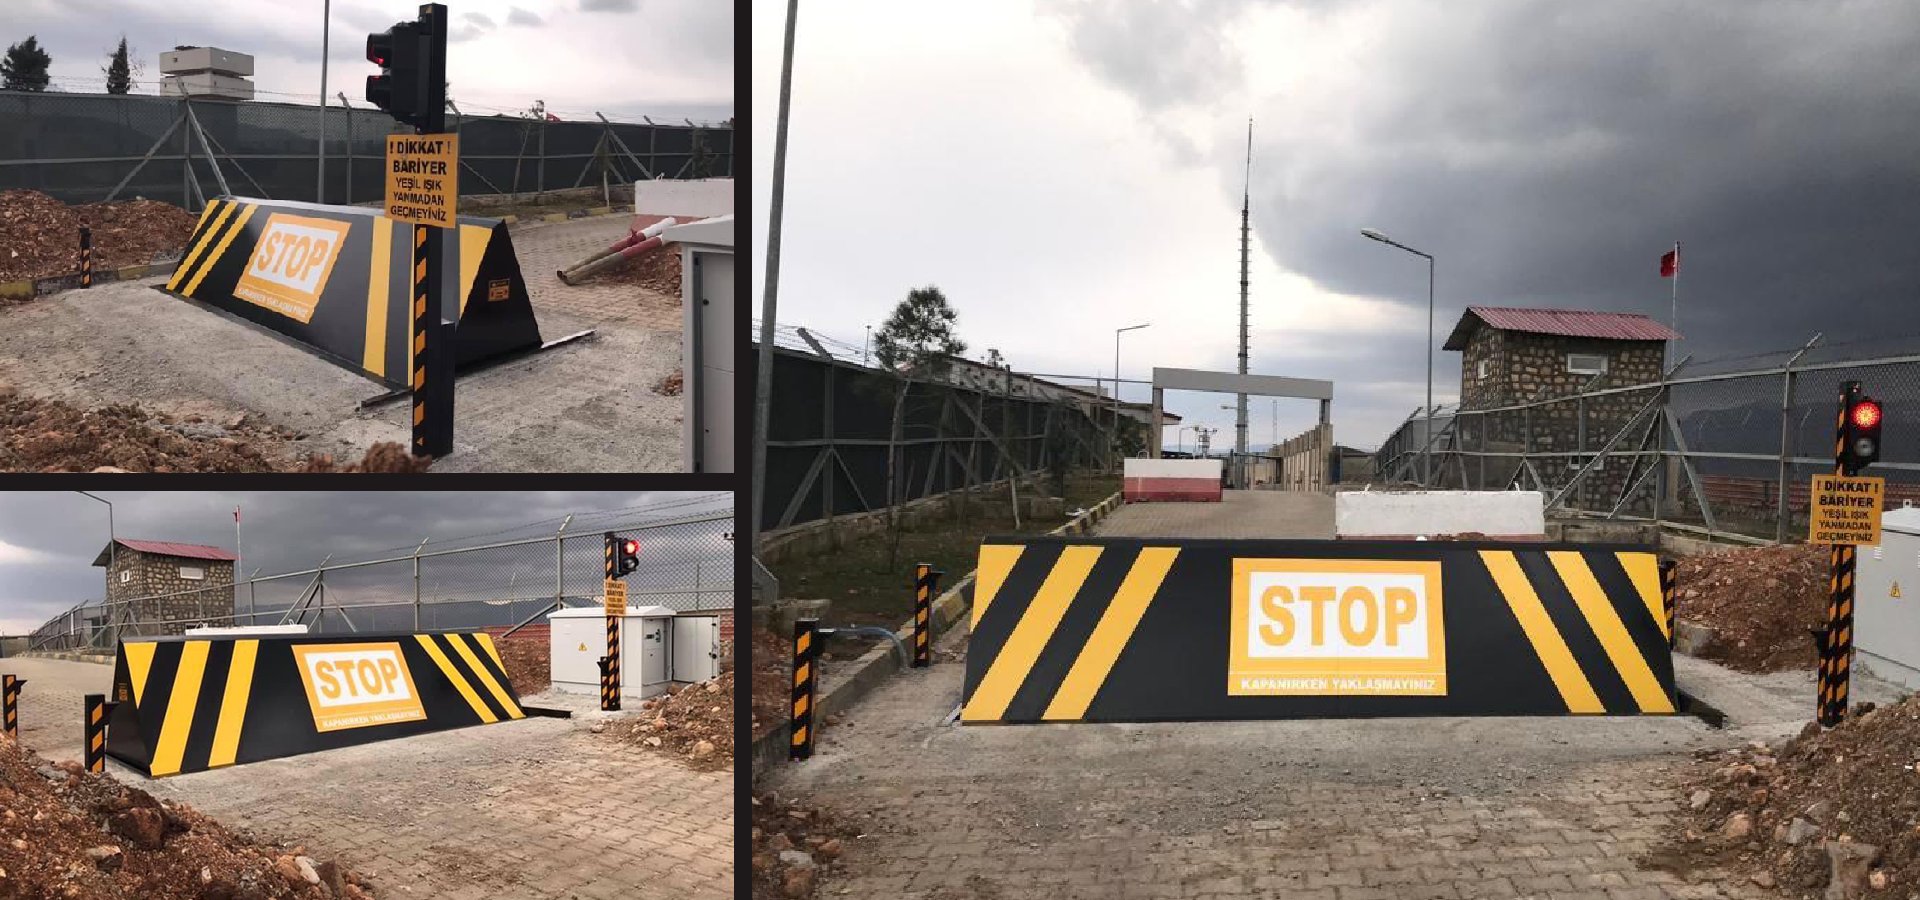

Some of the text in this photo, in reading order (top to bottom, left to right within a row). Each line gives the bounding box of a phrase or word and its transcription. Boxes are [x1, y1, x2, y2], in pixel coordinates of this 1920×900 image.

[397, 139, 443, 154] DİKKAT
[393, 158, 447, 175] BARİYER
[396, 176, 442, 192] YEŞİL IŞIK
[393, 191, 445, 206] YANMADAN
[390, 205, 447, 221] GEÇMEYİNİZ
[257, 230, 329, 281] STOP
[1825, 480, 1871, 492] DİKKAT
[1819, 494, 1874, 508] BARİYER
[1819, 520, 1872, 530] YANMADAN
[1258, 585, 1418, 647] STOP
[315, 658, 398, 699] STOP
[1241, 678, 1327, 690] KAPANIRKEN
